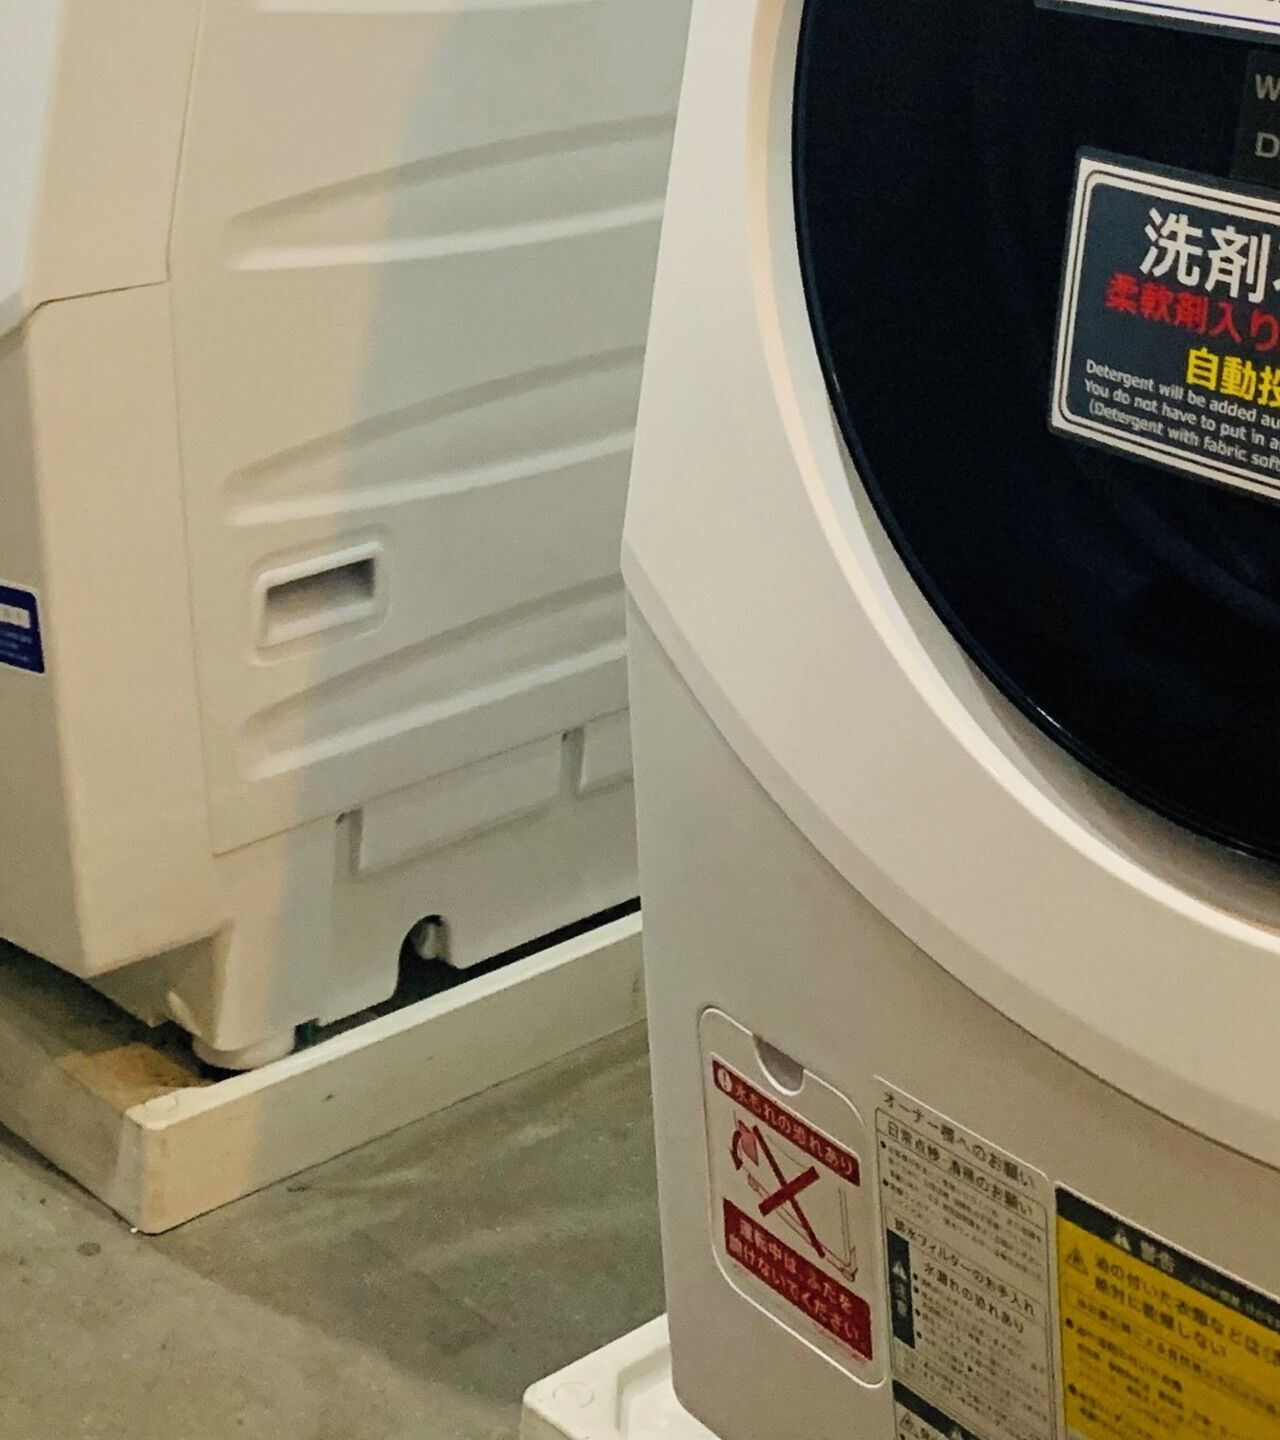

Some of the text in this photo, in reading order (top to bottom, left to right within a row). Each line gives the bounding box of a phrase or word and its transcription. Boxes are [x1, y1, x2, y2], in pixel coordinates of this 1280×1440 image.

[1084, 378, 1110, 399] You
[1112, 388, 1131, 405] do
[1133, 396, 1159, 415] not
[1161, 401, 1198, 426] have
[1200, 414, 1217, 432] to
[1219, 422, 1247, 441] put
[1251, 428, 1265, 447] in
[1086, 358, 1155, 393] Detergent
[1158, 383, 1184, 401] will
[1186, 389, 1206, 408] be
[1209, 399, 1257, 423] added
[1089, 399, 1165, 436] (Detergent
[1167, 426, 1201, 447] with
[1203, 435, 1248, 462] fabric
